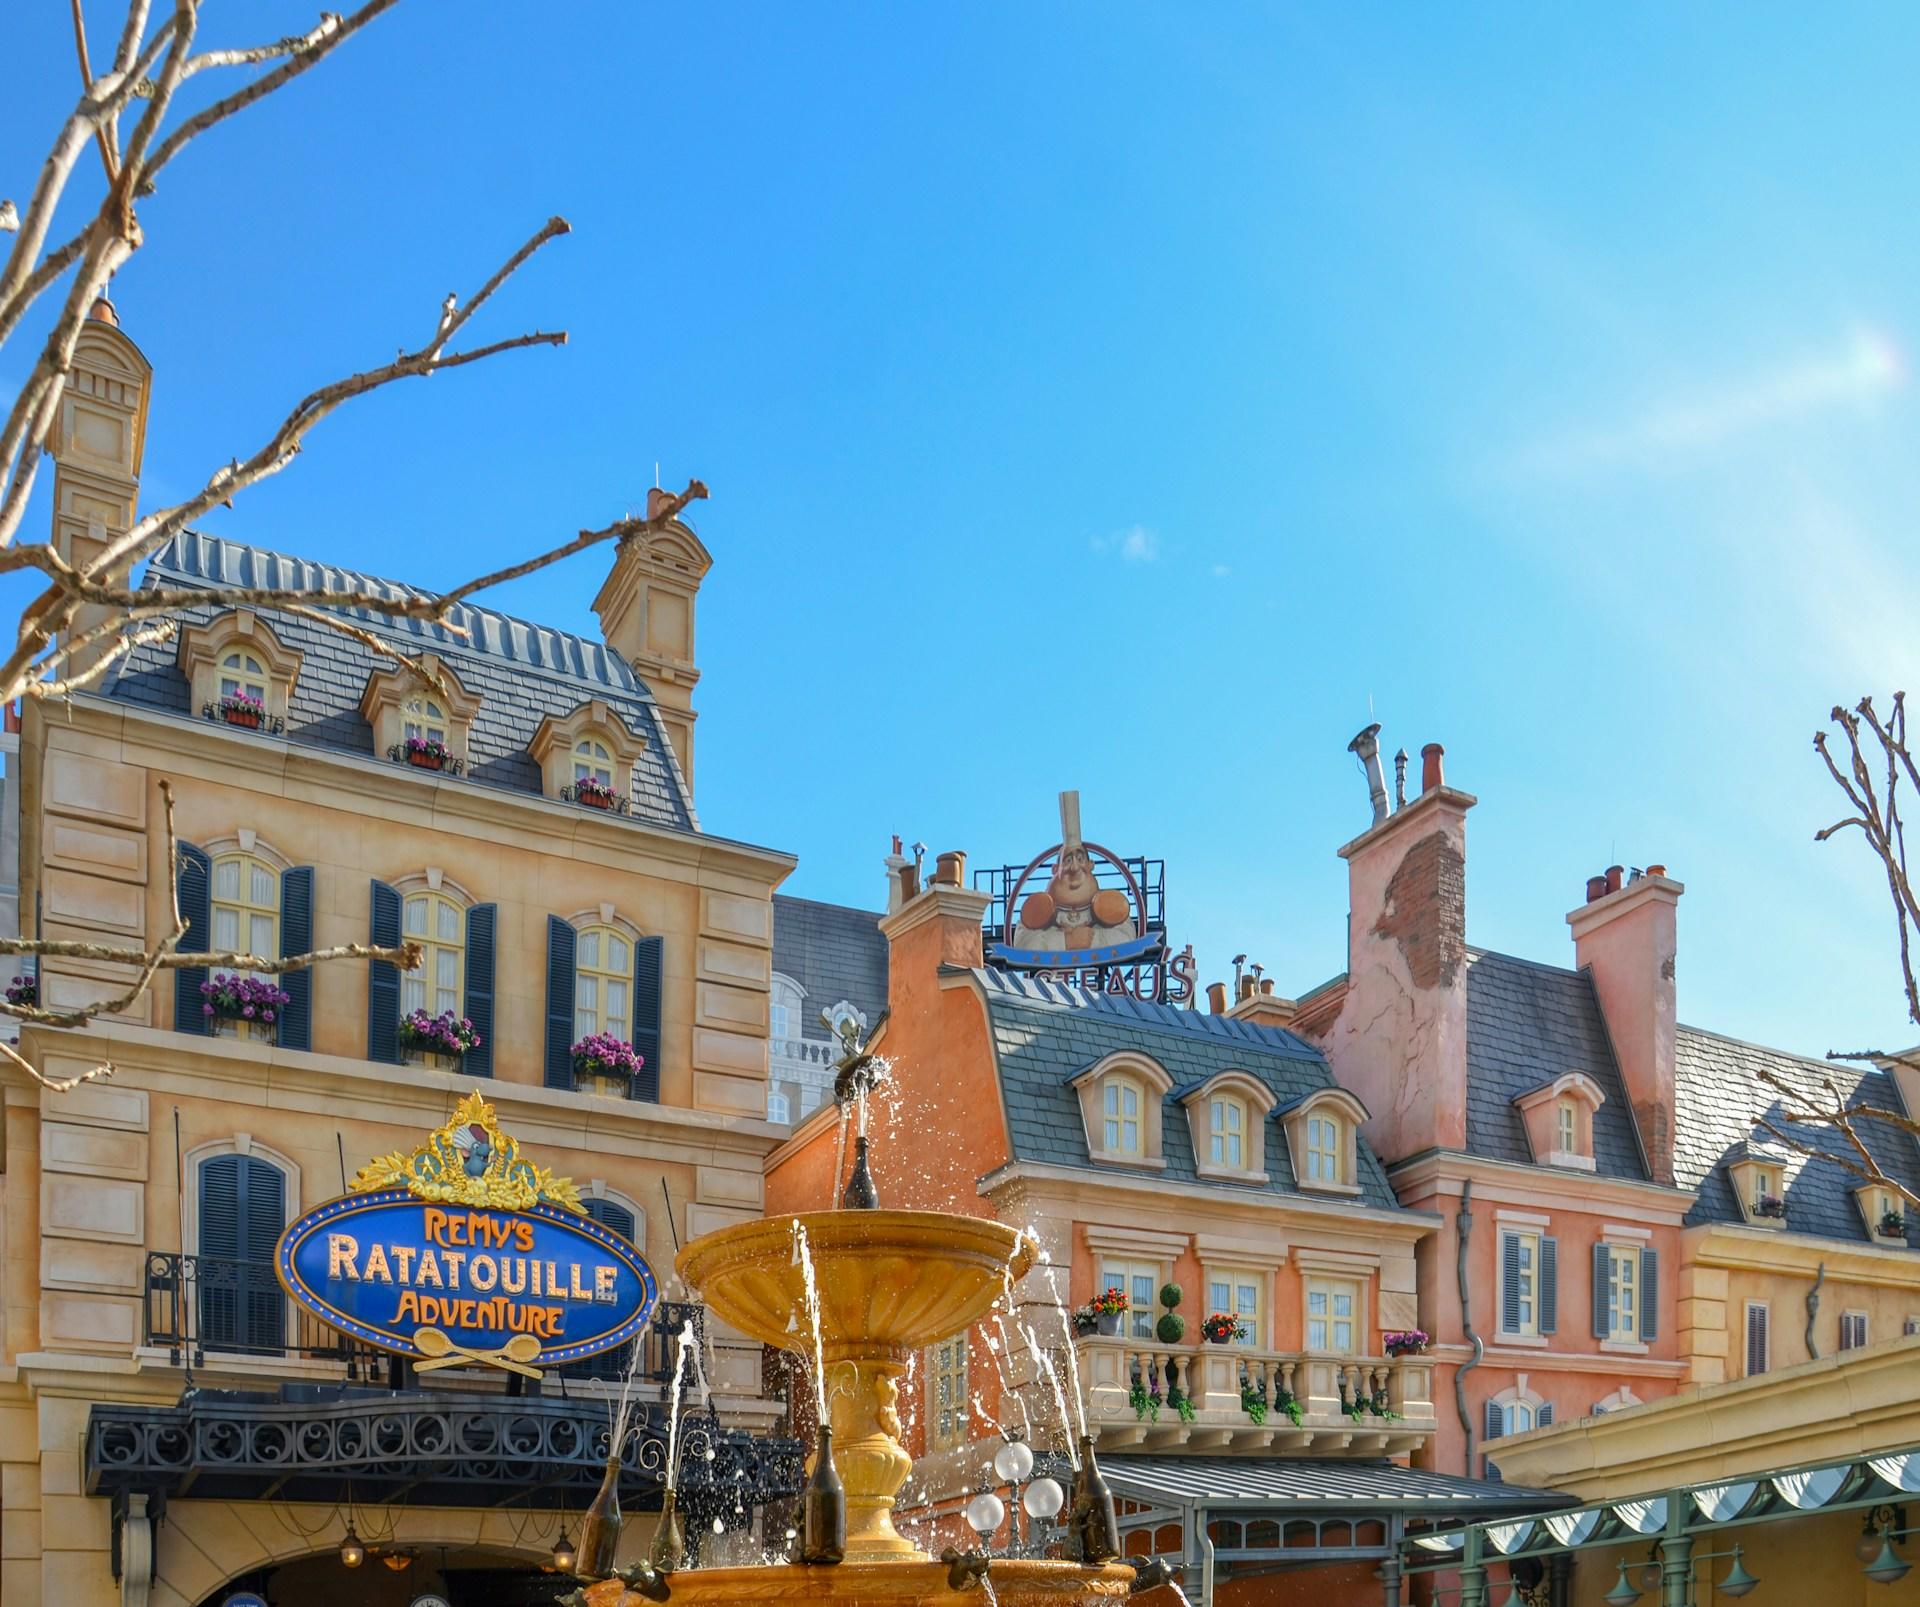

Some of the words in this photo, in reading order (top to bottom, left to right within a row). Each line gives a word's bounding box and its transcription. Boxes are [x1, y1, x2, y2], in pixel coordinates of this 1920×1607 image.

[423, 1207, 535, 1252] REMY'S
[327, 1232, 619, 1306] RATATOUILLE
[387, 1290, 565, 1338] ADVENTURE
